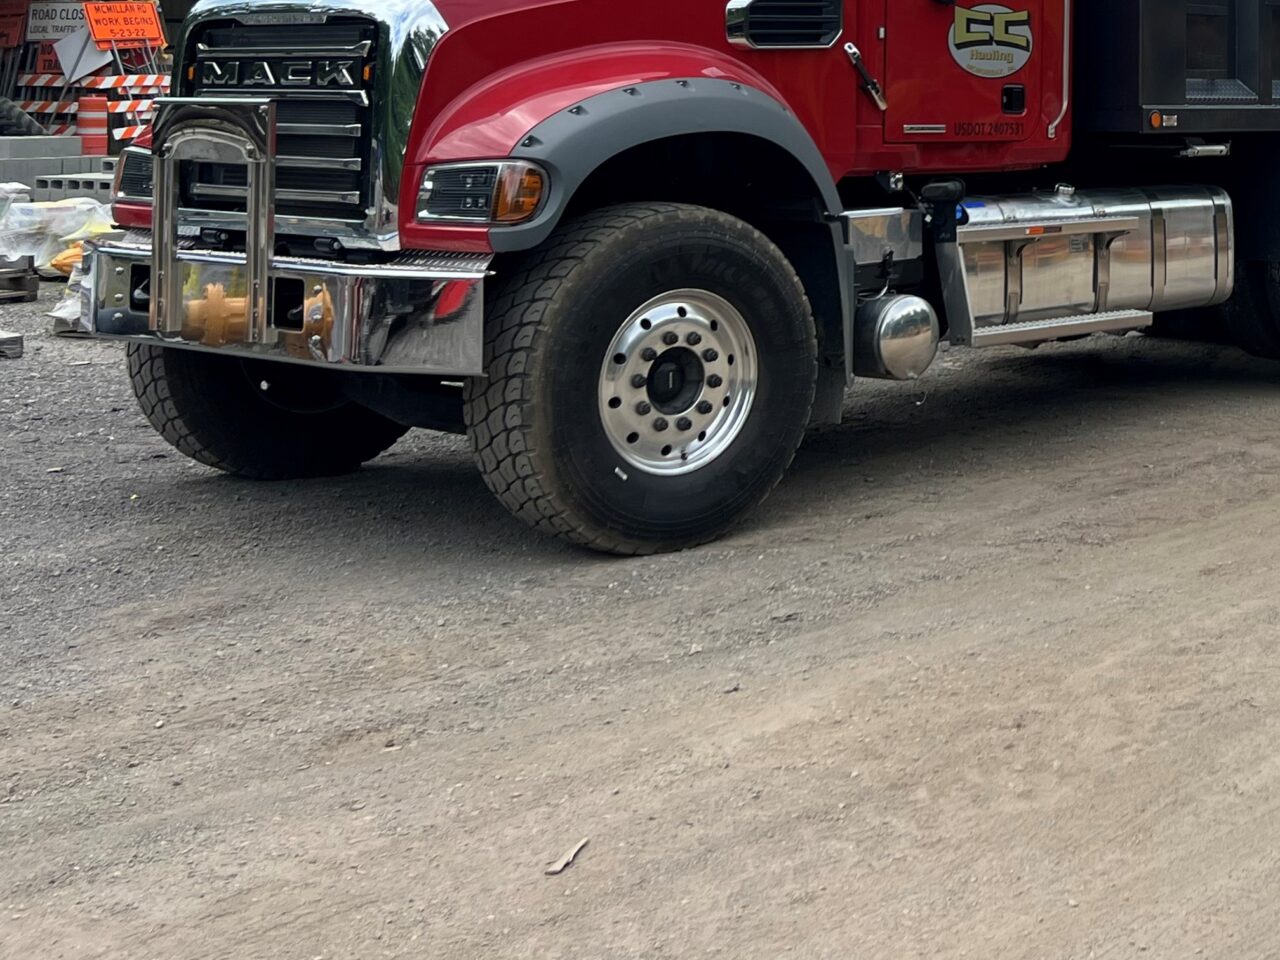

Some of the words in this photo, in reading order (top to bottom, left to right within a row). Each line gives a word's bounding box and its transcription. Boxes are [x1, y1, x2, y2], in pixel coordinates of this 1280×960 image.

[32, 8, 57, 20] ROAD
[60, 8, 85, 20] CLOS
[94, 4, 135, 14] MCMILLAN
[137, 4, 147, 14] RD
[94, 16, 121, 26] WORK
[123, 16, 153, 26] BEGINS
[30, 25, 48, 33] LOCAL
[110, 28, 146, 37] 5-23-22
[970, 49, 1014, 64] Hauling
[202, 60, 354, 85] MACK
[954, 123, 986, 136] USDOT
